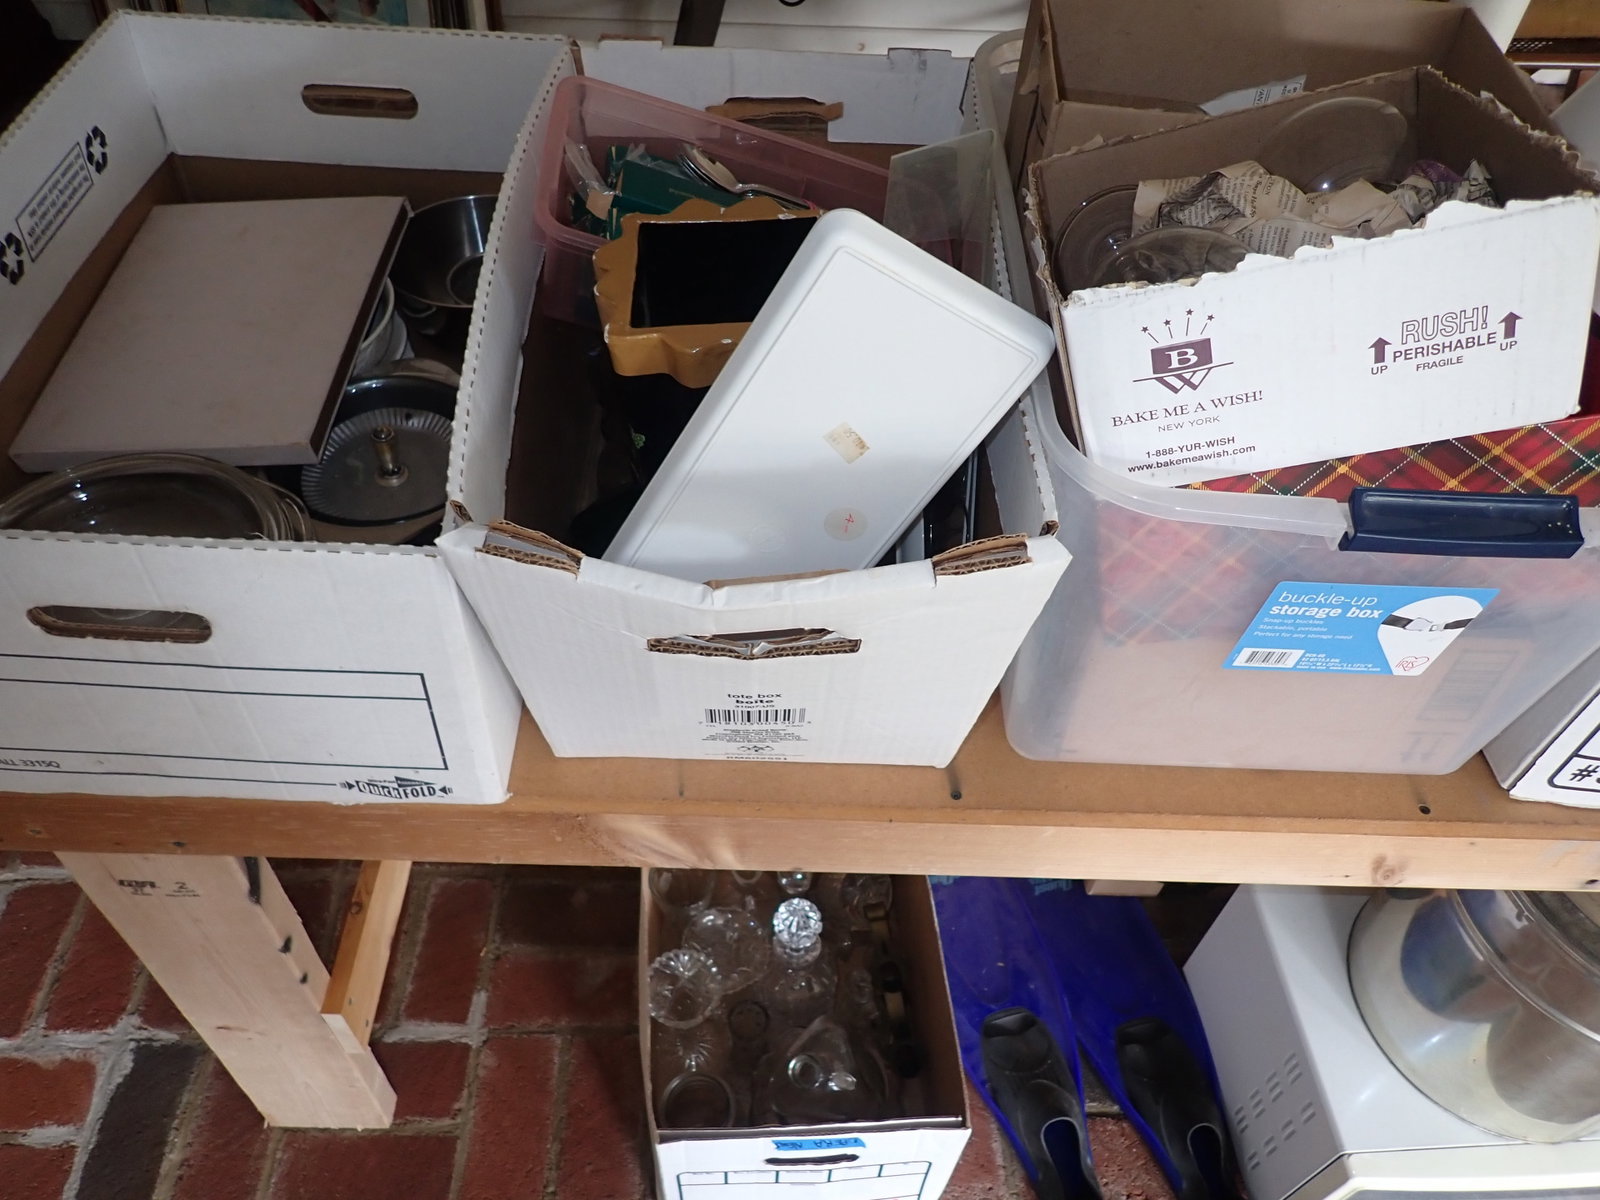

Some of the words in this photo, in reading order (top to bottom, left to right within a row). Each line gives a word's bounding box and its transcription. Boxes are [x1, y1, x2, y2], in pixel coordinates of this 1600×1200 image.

[1401, 305, 1489, 346] RUSH!
[1393, 331, 1497, 363] PERISHABLE
[1500, 340, 1518, 352] UP
[1371, 365, 1388, 376] UP
[1416, 355, 1464, 372] FRAGILE
[1111, 410, 1159, 428] BAKE
[1164, 404, 1190, 419] ME
[1194, 401, 1207, 414] A
[1210, 390, 1264, 409] WISH!
[1158, 421, 1185, 433] NEW
[1188, 415, 1221, 427] YORK
[1146, 436, 1236, 459] 1-888-YUR-WISH
[1128, 445, 1256, 473] www.bakemeawish.com
[1278, 591, 1378, 607] buckle-up
[1269, 604, 1342, 619] storage
[1345, 606, 1384, 619] box
[402, 785, 437, 799] FOLD
